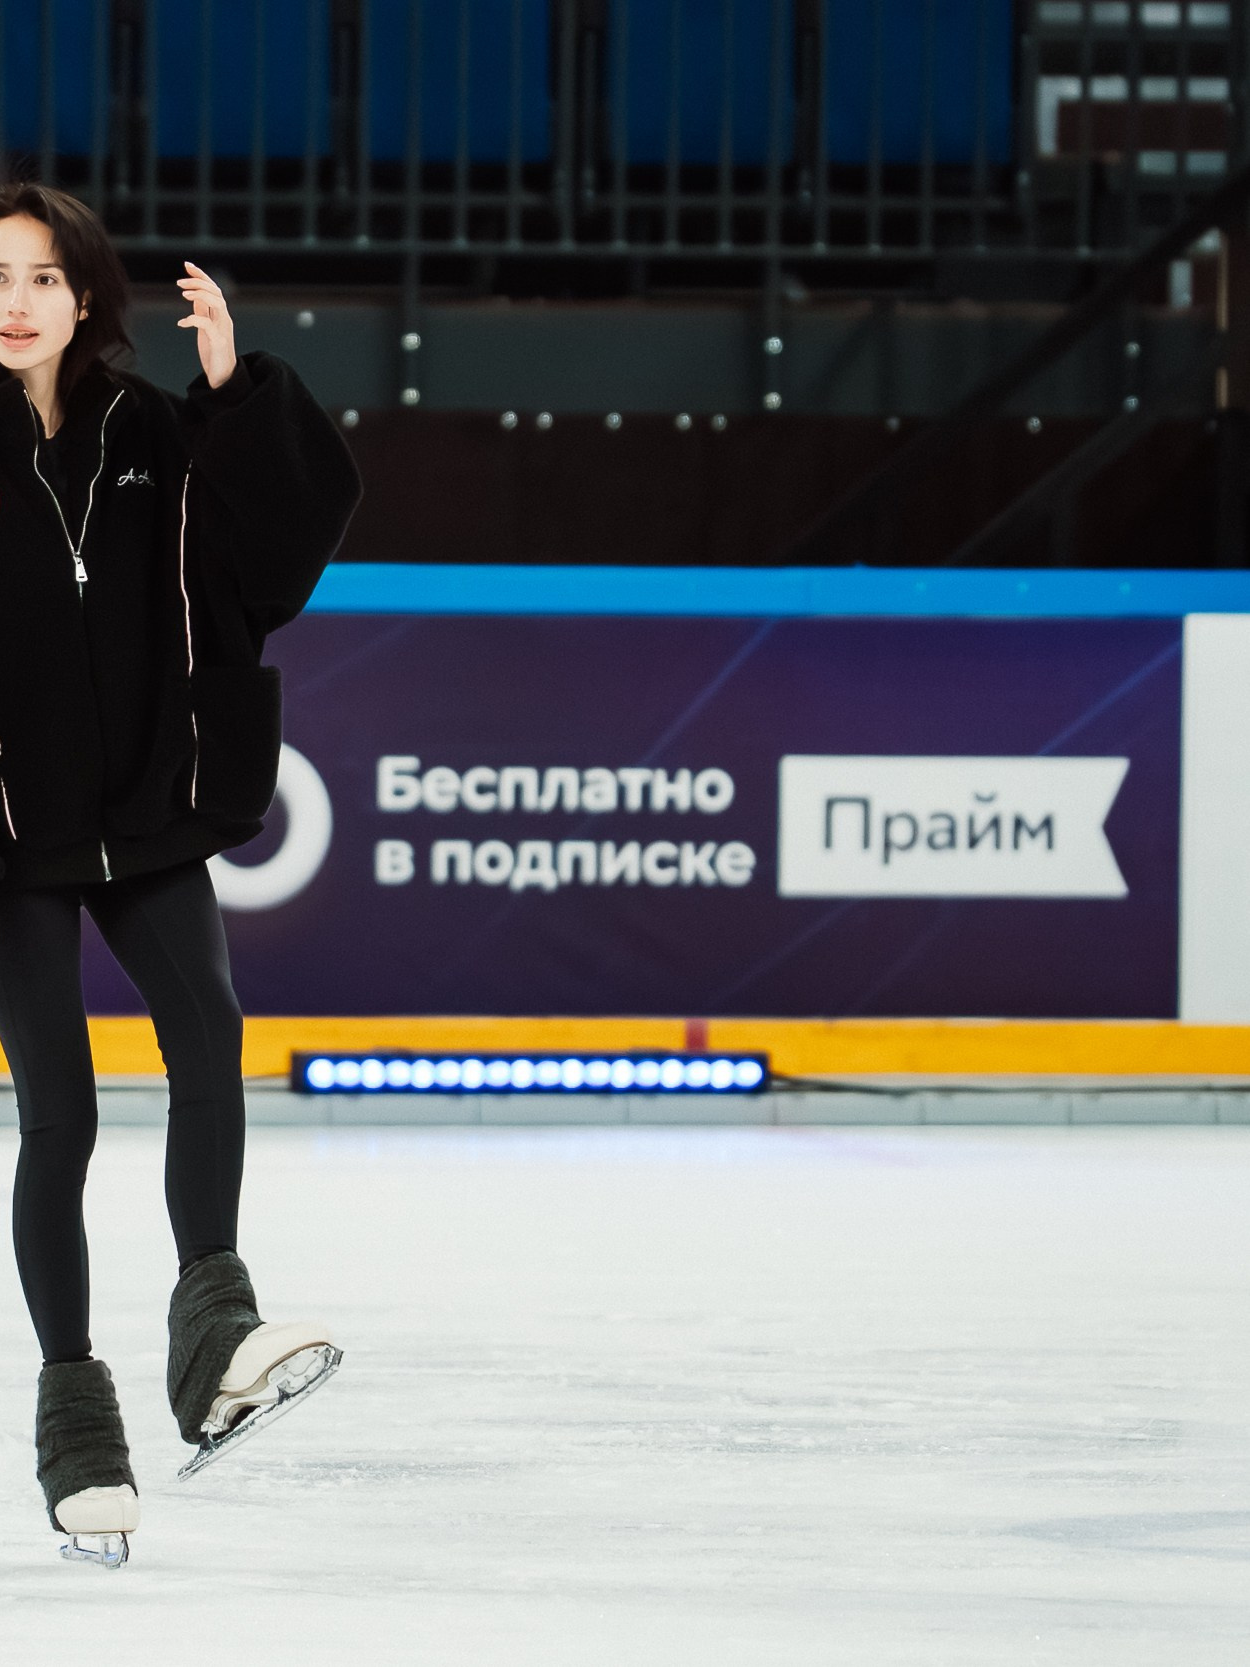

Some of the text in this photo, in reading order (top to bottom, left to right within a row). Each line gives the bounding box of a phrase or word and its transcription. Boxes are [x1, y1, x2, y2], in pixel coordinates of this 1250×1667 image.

[375, 755, 736, 813] Бесплатно
[824, 791, 1056, 866] Прайм
[374, 839, 757, 892] в подписке
